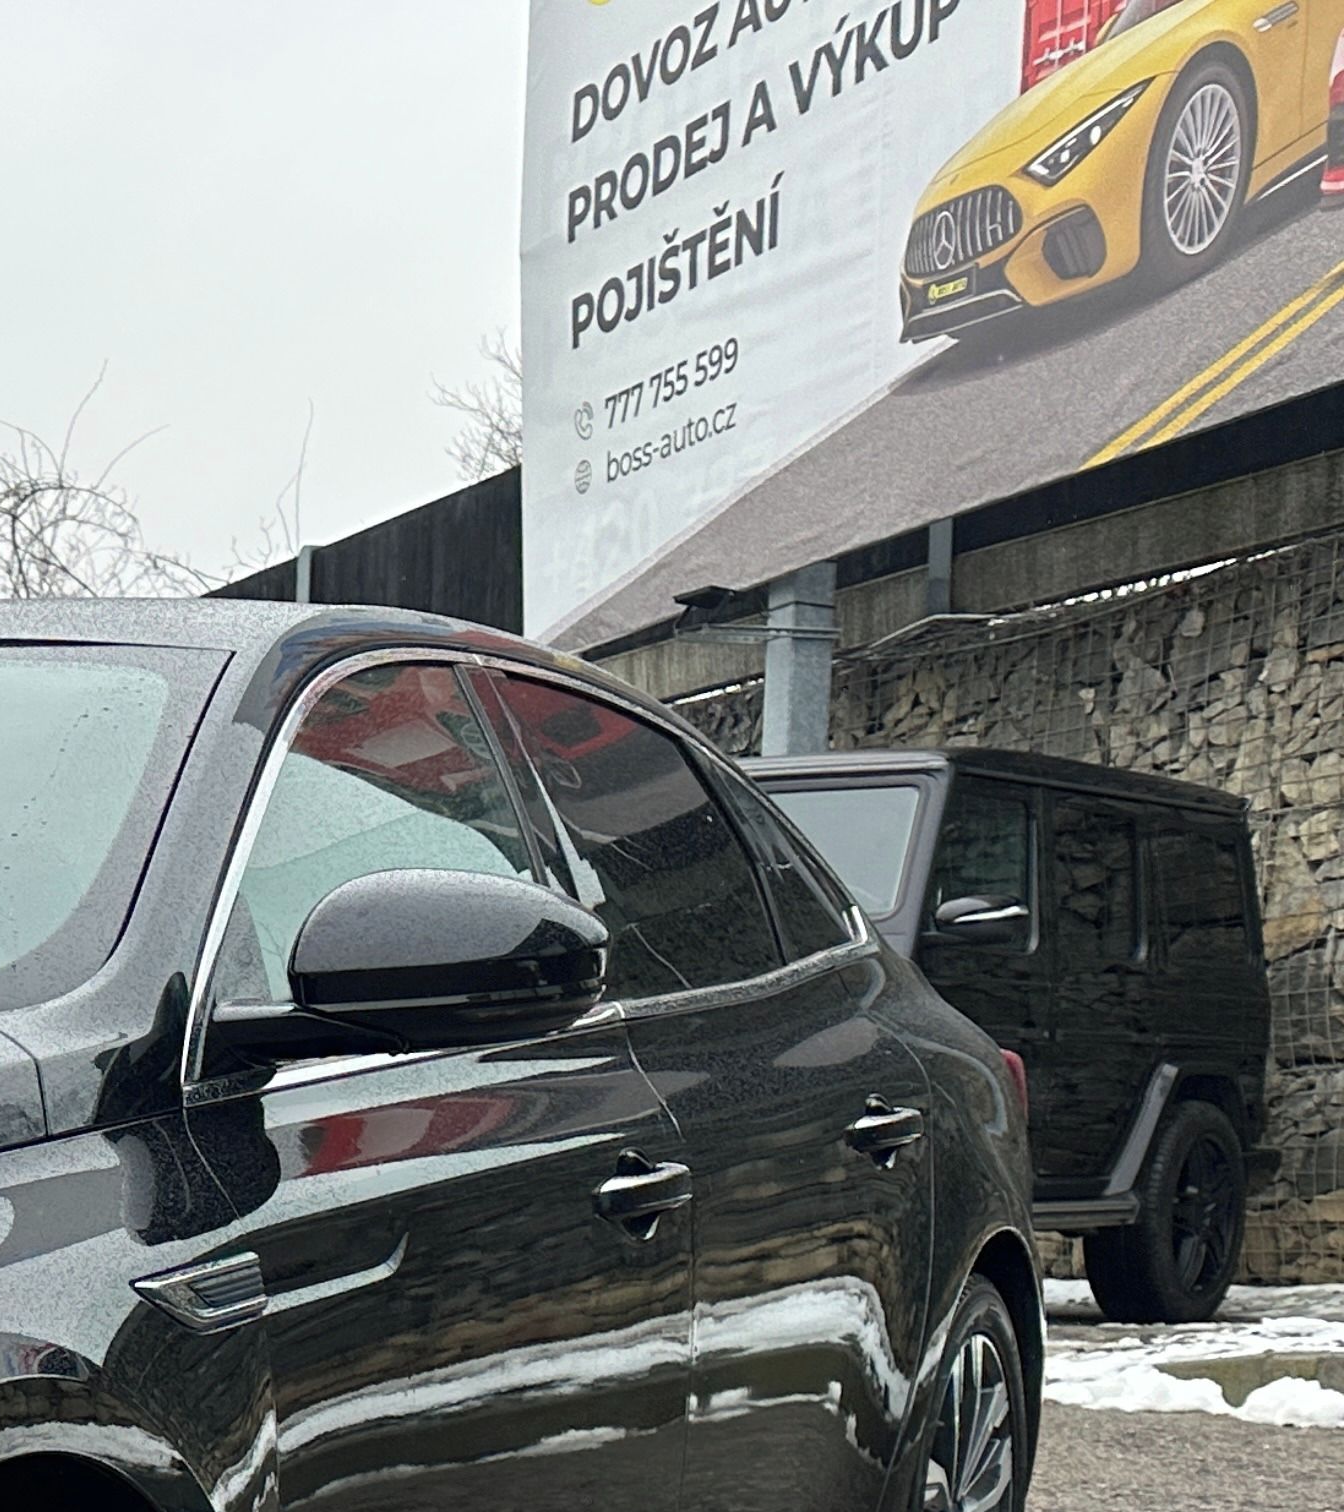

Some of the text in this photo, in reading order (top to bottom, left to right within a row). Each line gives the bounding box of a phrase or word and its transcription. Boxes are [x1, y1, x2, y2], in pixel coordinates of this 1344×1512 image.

[568, 100, 731, 244] PRODEJ
[740, 79, 777, 147] A
[788, 0, 960, 116] VÝKUP
[571, 2, 719, 143] DOVOZ
[572, 170, 784, 350] POJIŠTĚNÍ
[604, 337, 739, 429] 777 755 599
[606, 402, 737, 482] boss-auto.cz
